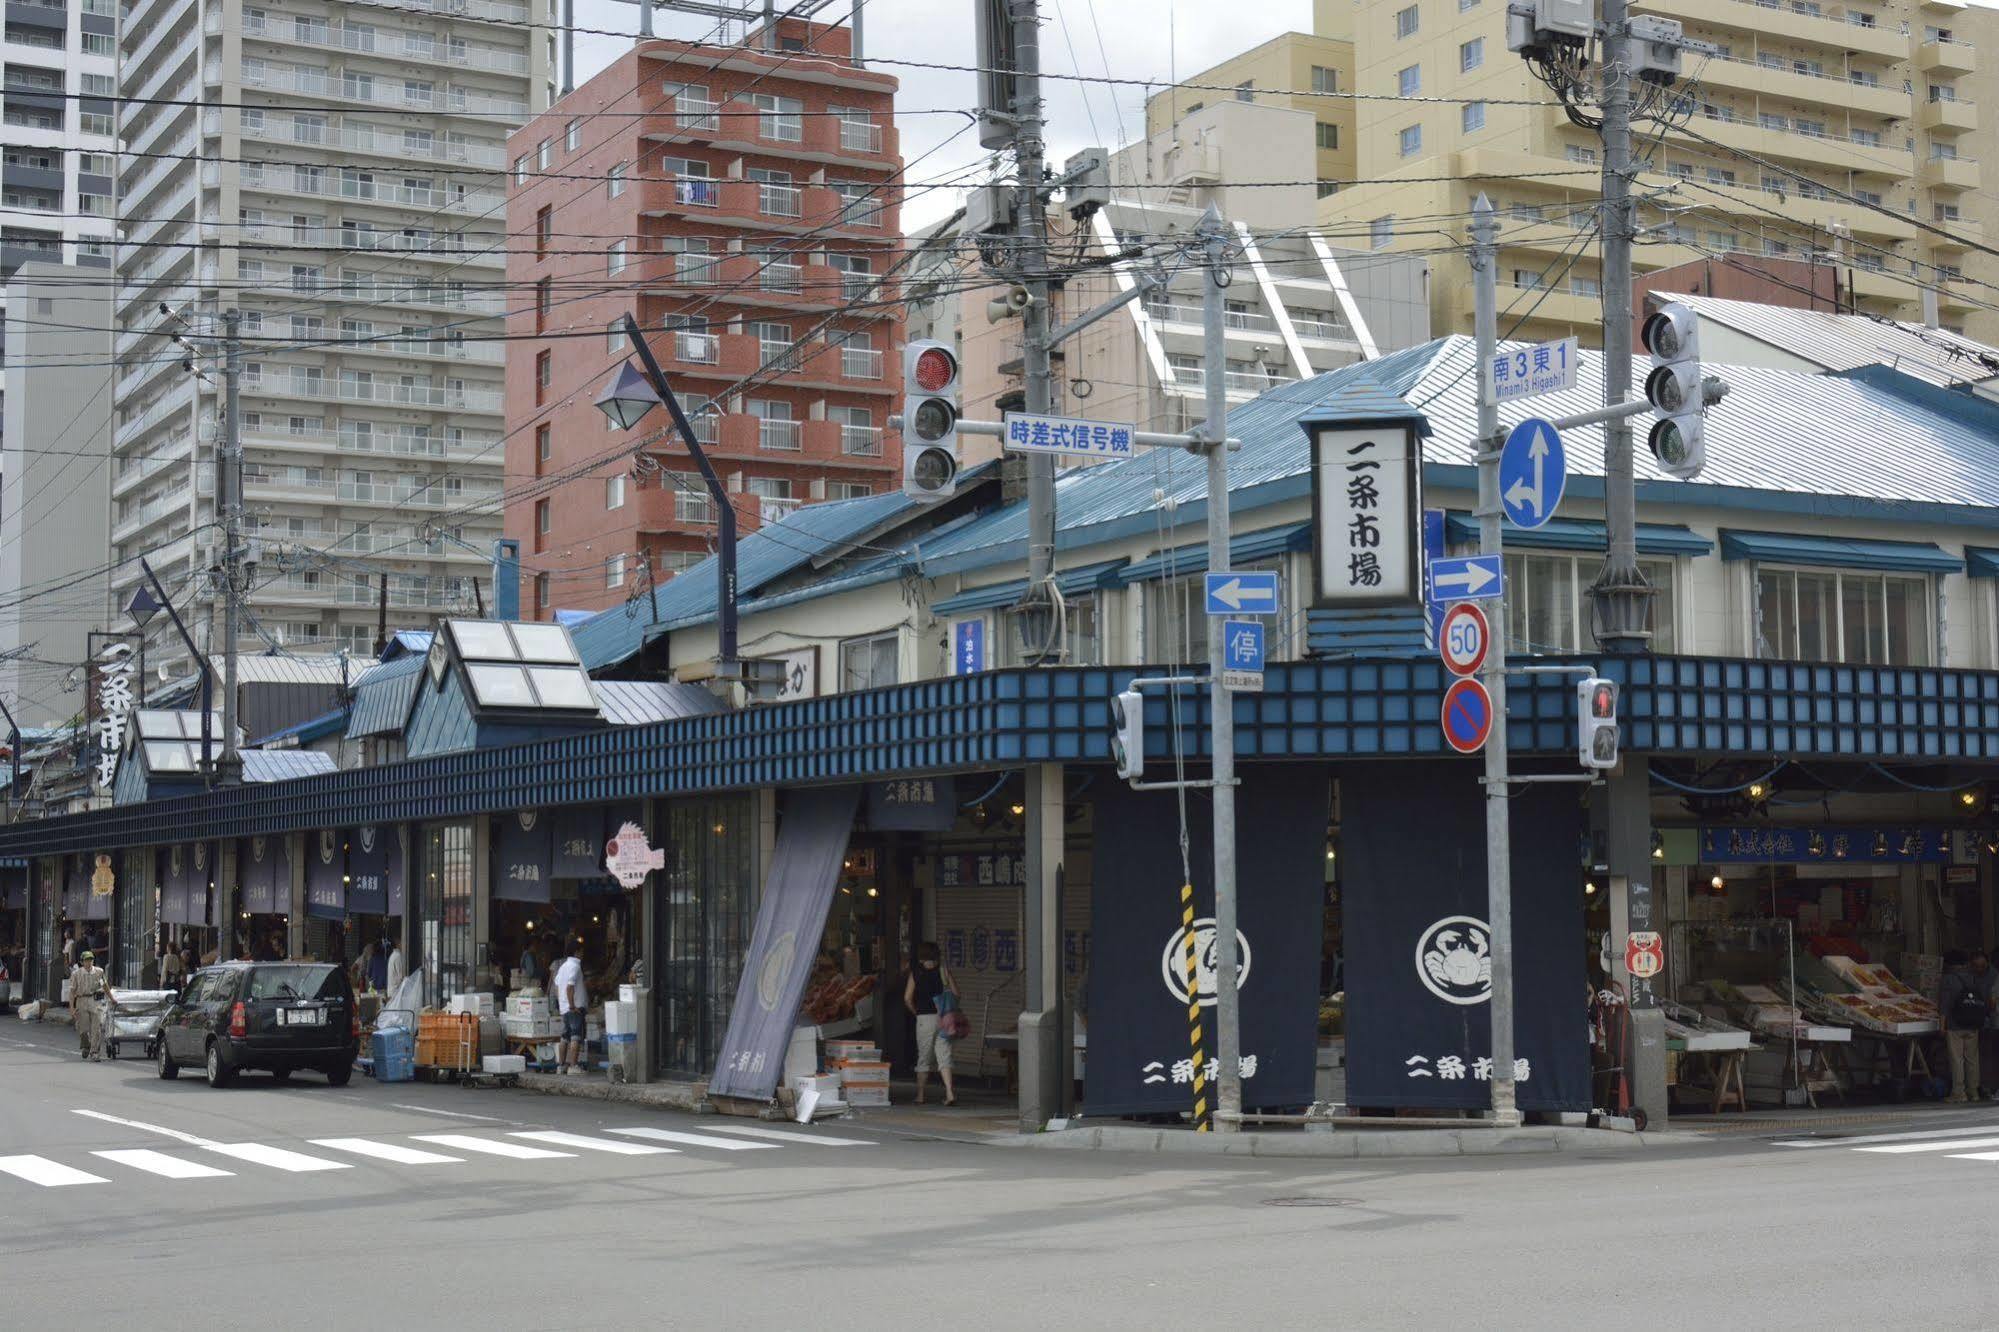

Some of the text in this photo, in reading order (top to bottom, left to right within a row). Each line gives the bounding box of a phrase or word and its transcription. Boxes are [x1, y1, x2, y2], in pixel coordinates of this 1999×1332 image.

[1493, 342, 1567, 383] 南3東1
[1495, 381, 1523, 399] Minami
[1524, 380, 1530, 393] 3
[1532, 371, 1561, 391] Higashi
[1010, 419, 1130, 453] 時差式信号機
[1346, 441, 1381, 588] 二条市場
[1230, 630, 1258, 663] 停
[1449, 624, 1477, 655] 50
